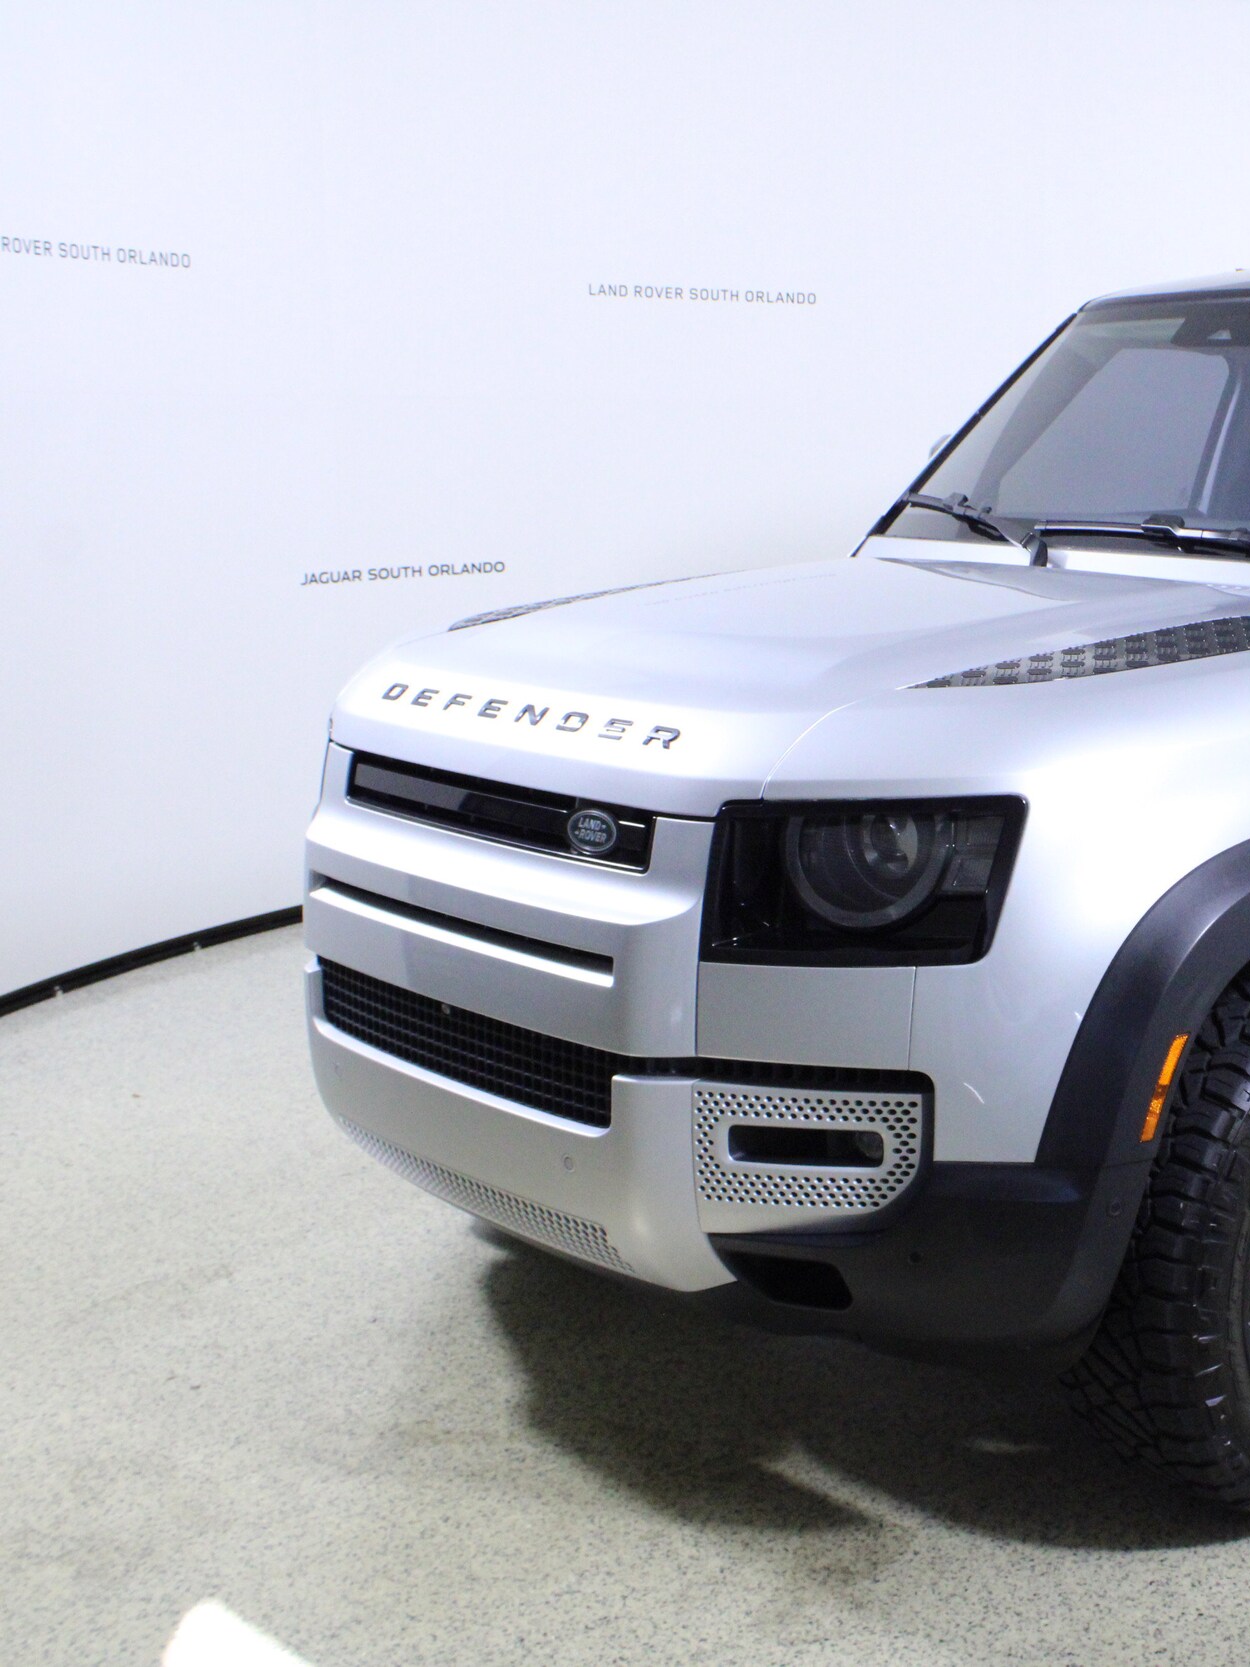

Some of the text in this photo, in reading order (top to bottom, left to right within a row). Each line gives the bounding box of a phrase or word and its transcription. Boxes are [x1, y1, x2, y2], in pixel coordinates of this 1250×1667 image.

[1, 236, 191, 269] ROVER SOUTH ORLANDO
[588, 284, 817, 305] LAND ROVER SOUTH ORLANDO
[301, 561, 505, 586] JAGUAR SOUTH ORLANDO
[381, 682, 681, 750] DEFENDER
[578, 828, 607, 843] ROVER
